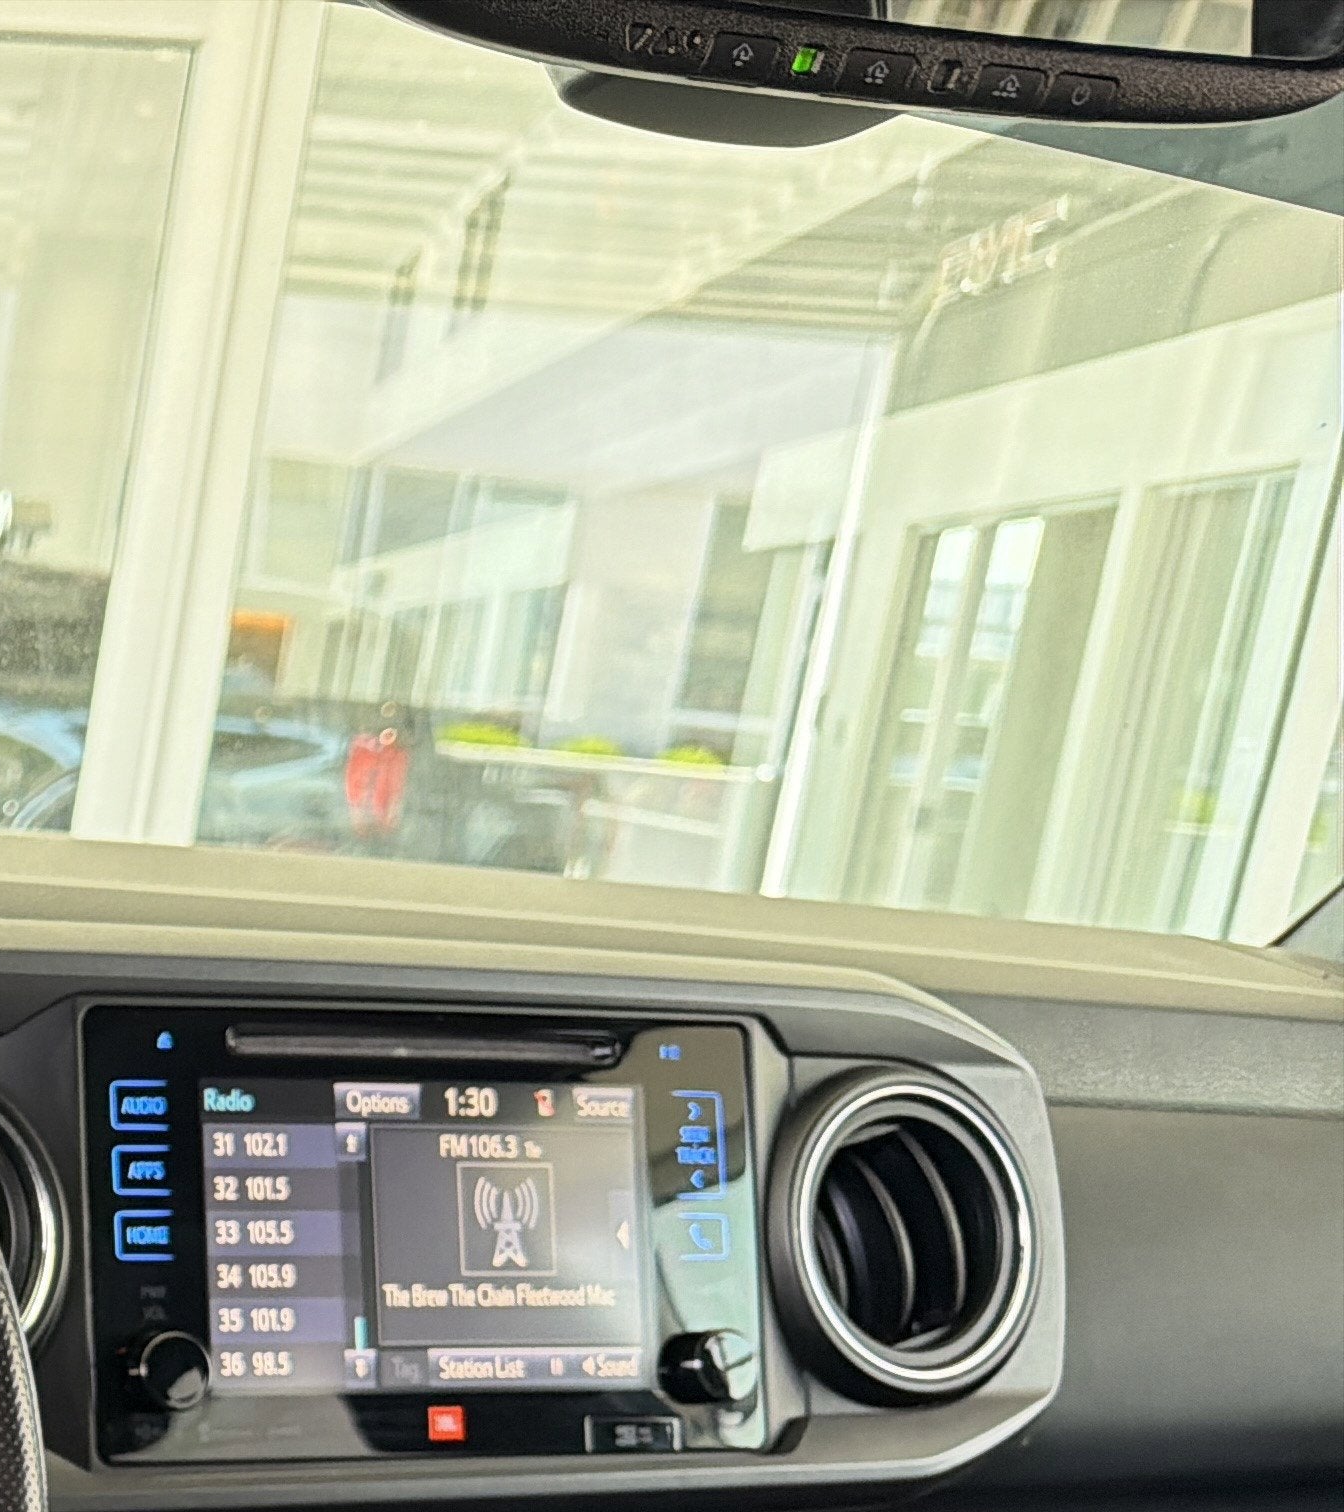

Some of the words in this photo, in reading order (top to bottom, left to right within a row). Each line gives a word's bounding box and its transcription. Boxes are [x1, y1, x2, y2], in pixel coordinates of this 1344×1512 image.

[121, 1096, 167, 1115] AUDIO
[203, 1087, 256, 1112] Radio
[346, 1089, 410, 1117] Options
[444, 1086, 498, 1117] 1:30
[576, 1094, 630, 1118] Source
[212, 1132, 235, 1156] 31
[243, 1132, 288, 1157] 102.1
[127, 1161, 165, 1180] APPS
[213, 1175, 239, 1201] 32
[245, 1175, 291, 1201] 101.5
[215, 1219, 240, 1245] 33
[246, 1219, 294, 1245] 105.5
[216, 1263, 243, 1289] 34
[248, 1263, 297, 1289] 105.9
[382, 1283, 410, 1307] The
[412, 1283, 448, 1307] Brew
[448, 1283, 476, 1307] The
[218, 1307, 244, 1333] 35
[250, 1307, 295, 1333] 101.9
[220, 1351, 245, 1377] 36
[252, 1351, 292, 1377] 98.5
[439, 1355, 494, 1379] Station
[495, 1355, 526, 1379] List
[597, 1355, 637, 1377] Sound
